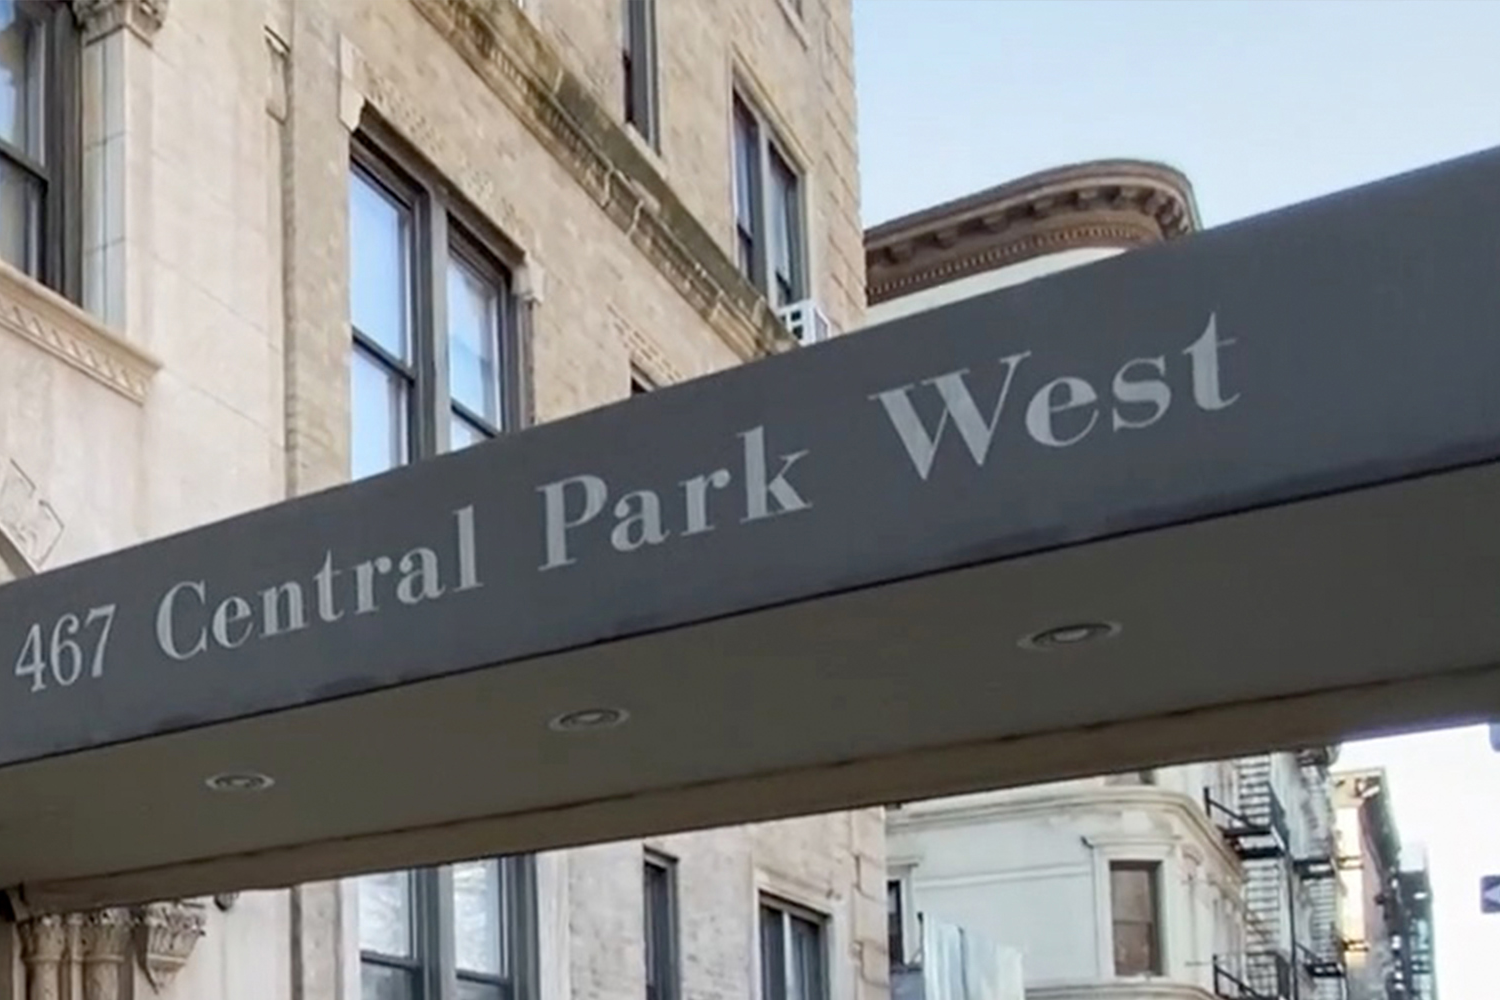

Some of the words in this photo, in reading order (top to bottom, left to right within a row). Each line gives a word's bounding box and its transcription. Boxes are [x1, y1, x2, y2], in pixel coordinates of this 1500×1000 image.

[14, 603, 117, 693] 467
[155, 504, 483, 661] Central
[535, 424, 813, 572] Park
[867, 311, 1241, 481] West
